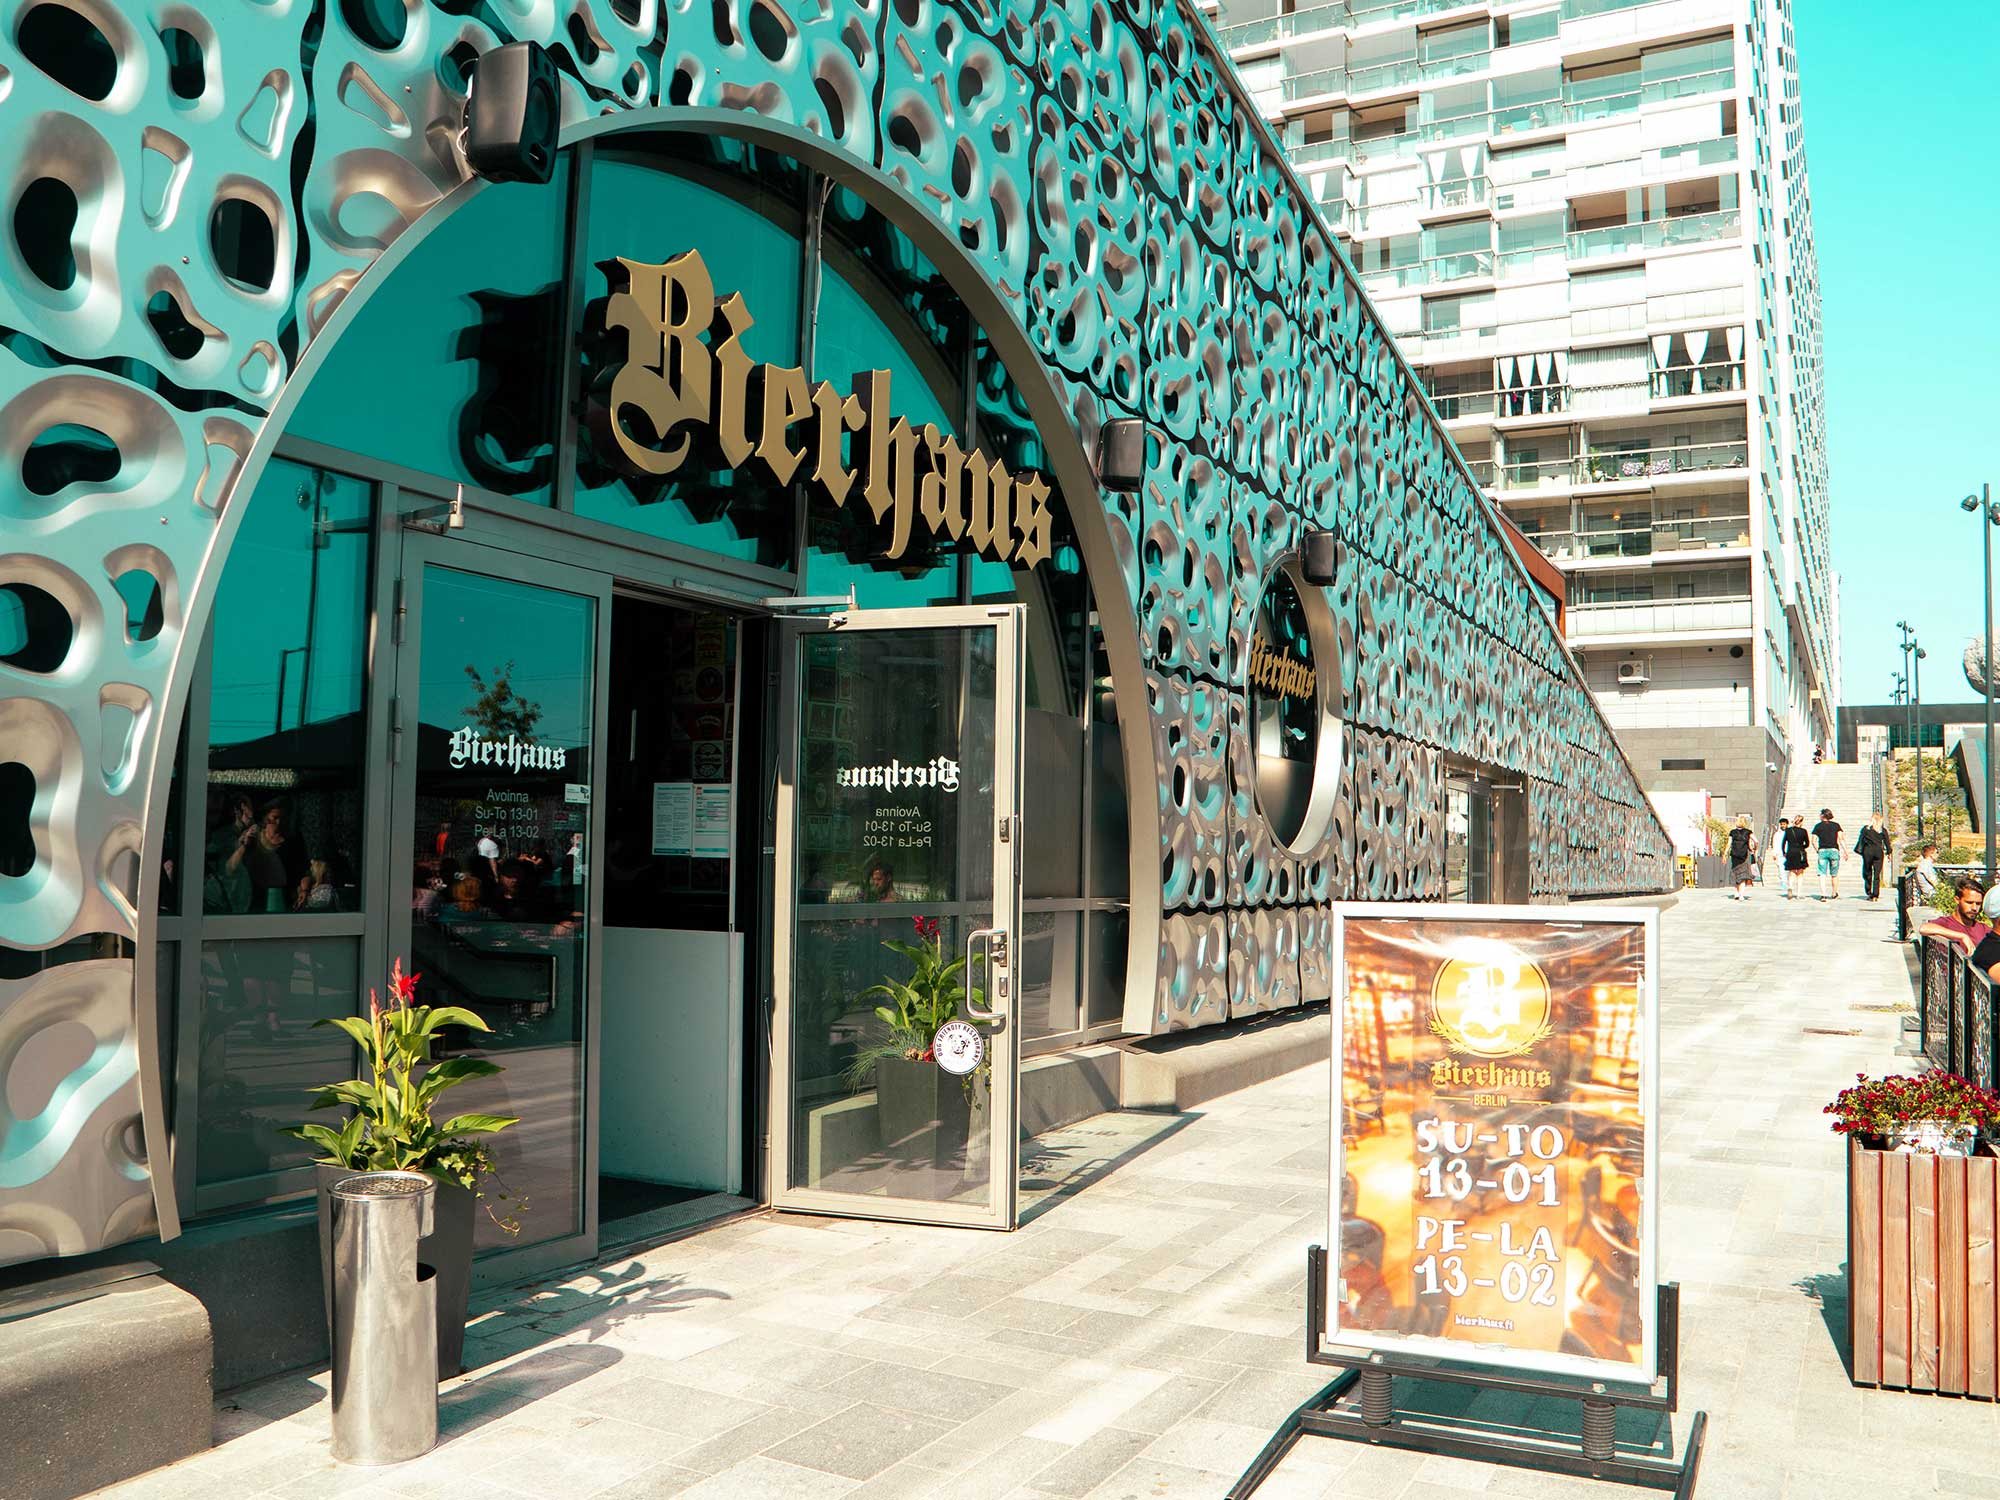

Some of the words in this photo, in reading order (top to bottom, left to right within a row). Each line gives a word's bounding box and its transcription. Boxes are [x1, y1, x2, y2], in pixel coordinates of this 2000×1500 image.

[603, 248, 1052, 571] Bierhaus
[448, 726, 566, 774] Bierhaus
[487, 788, 529, 802] Avoinna
[475, 806, 507, 820] Su-To
[511, 808, 538, 821] 13-01
[474, 824, 507, 838] Pe-La
[510, 825, 539, 838] 13-02
[1431, 1057, 1551, 1090] Bierhaus
[1473, 1094, 1507, 1107] BERLIN
